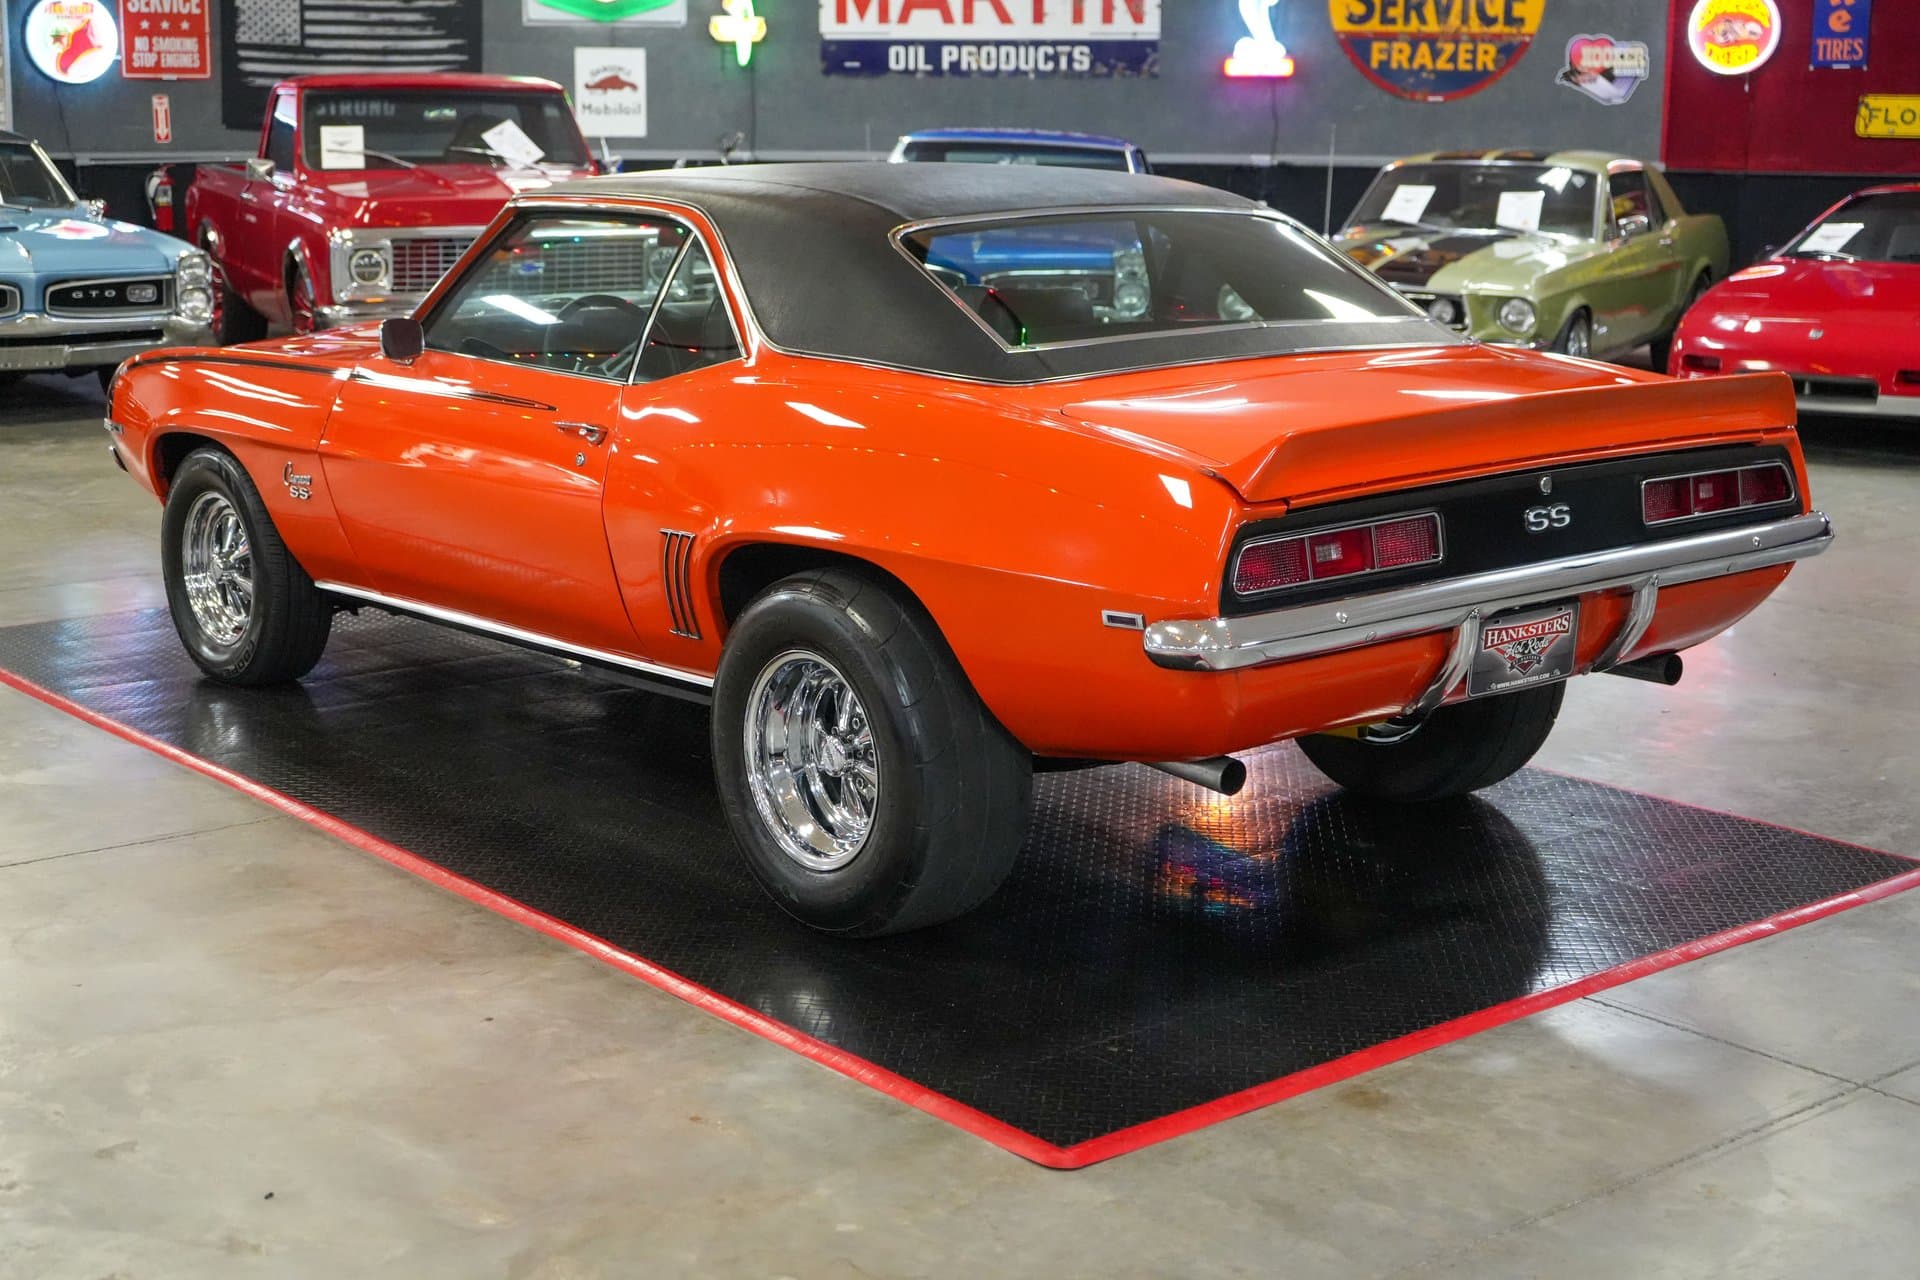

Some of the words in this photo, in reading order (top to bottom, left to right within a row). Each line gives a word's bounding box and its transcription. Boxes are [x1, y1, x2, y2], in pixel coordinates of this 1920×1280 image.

[134, 36, 149, 52] NO
[152, 37, 199, 53] SMOKING
[1816, 38, 1864, 62] TIRES
[132, 52, 158, 68] STOP
[161, 53, 200, 69] ENGINES
[888, 45, 934, 71] OIL
[941, 45, 1091, 72] PRODUCTS
[1370, 40, 1498, 72] FRAZER
[72, 289, 117, 299] GTO
[289, 485, 310, 501] SS
[1525, 504, 1571, 532] SS
[1486, 615, 1570, 647] HANKSTERS
[1504, 640, 1527, 657] Hot
[1525, 637, 1549, 654] Rods
